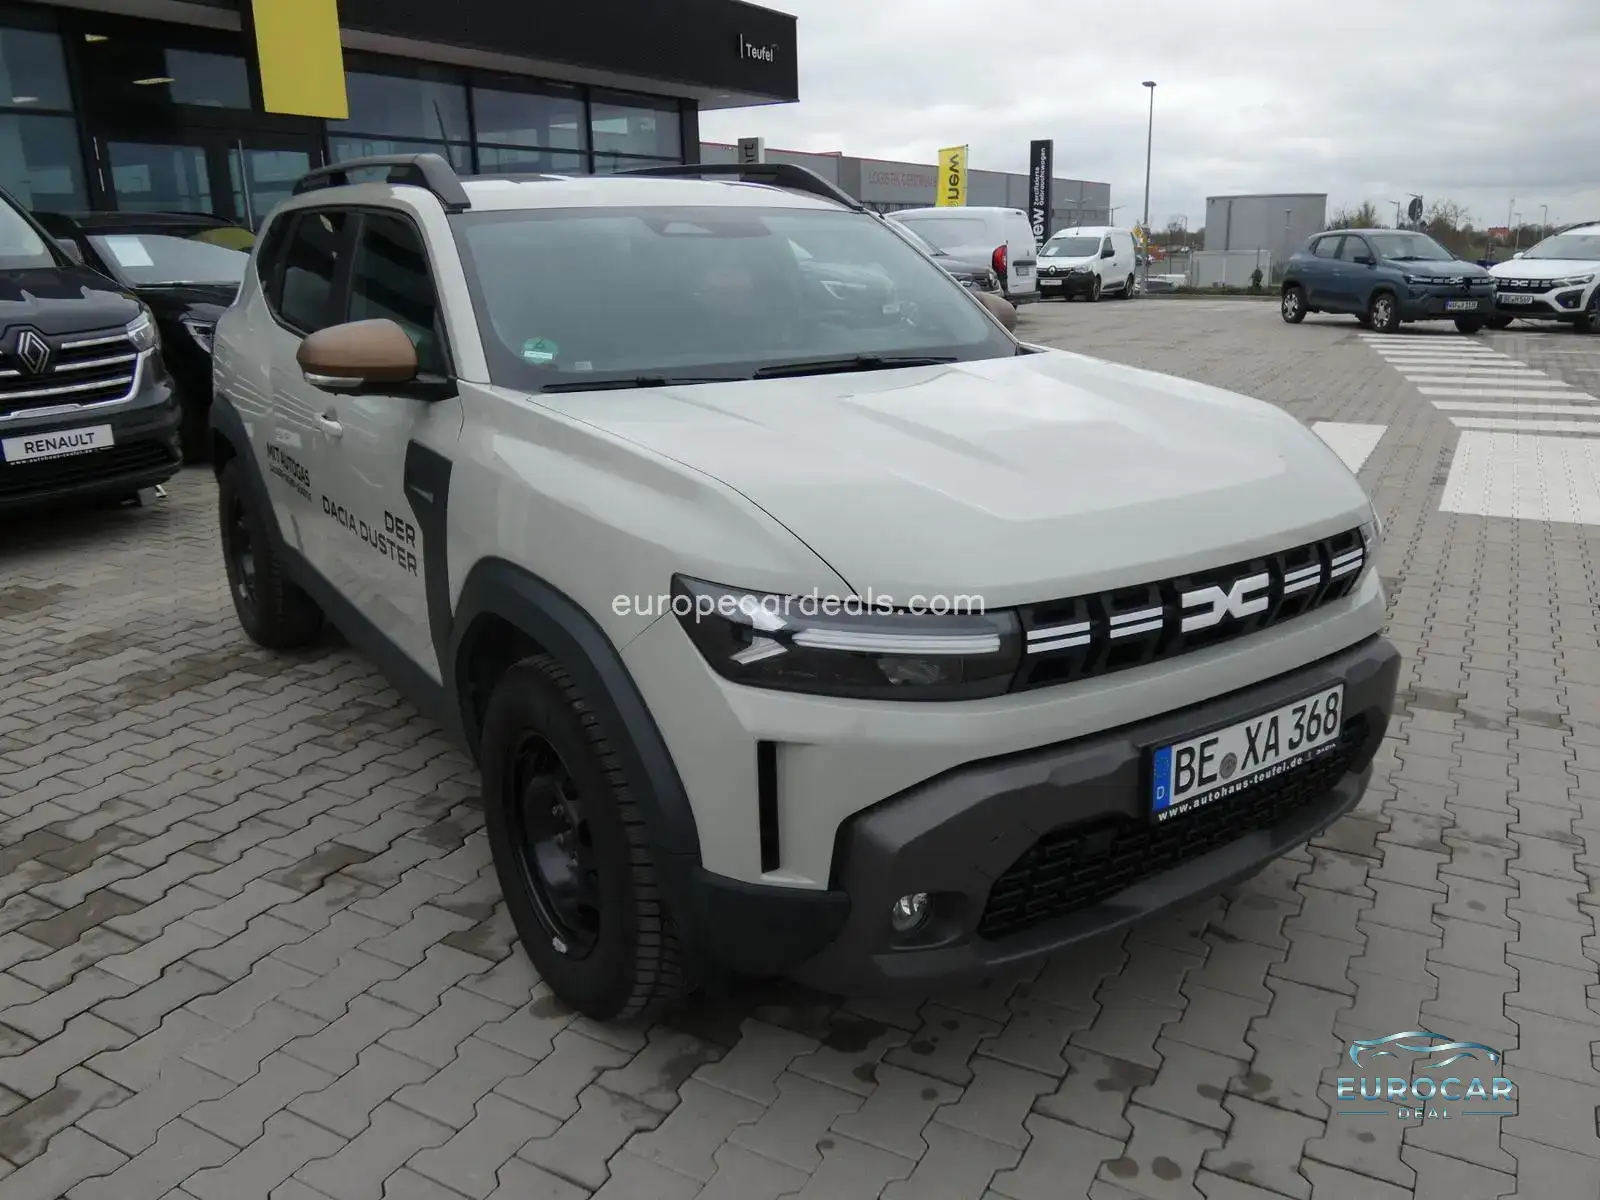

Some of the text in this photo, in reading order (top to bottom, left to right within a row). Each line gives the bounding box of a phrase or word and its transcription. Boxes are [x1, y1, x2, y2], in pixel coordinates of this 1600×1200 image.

[745, 43, 773, 62] Teufel
[1033, 208, 1045, 250] new
[24, 432, 95, 454] RENAULT
[322, 495, 418, 577] DACIA DUSTER
[384, 510, 416, 548] DER
[1174, 692, 1339, 796] BE XA 368
[1156, 786, 1165, 800] D
[1157, 757, 1303, 822] www.autohaus-teufel.de
